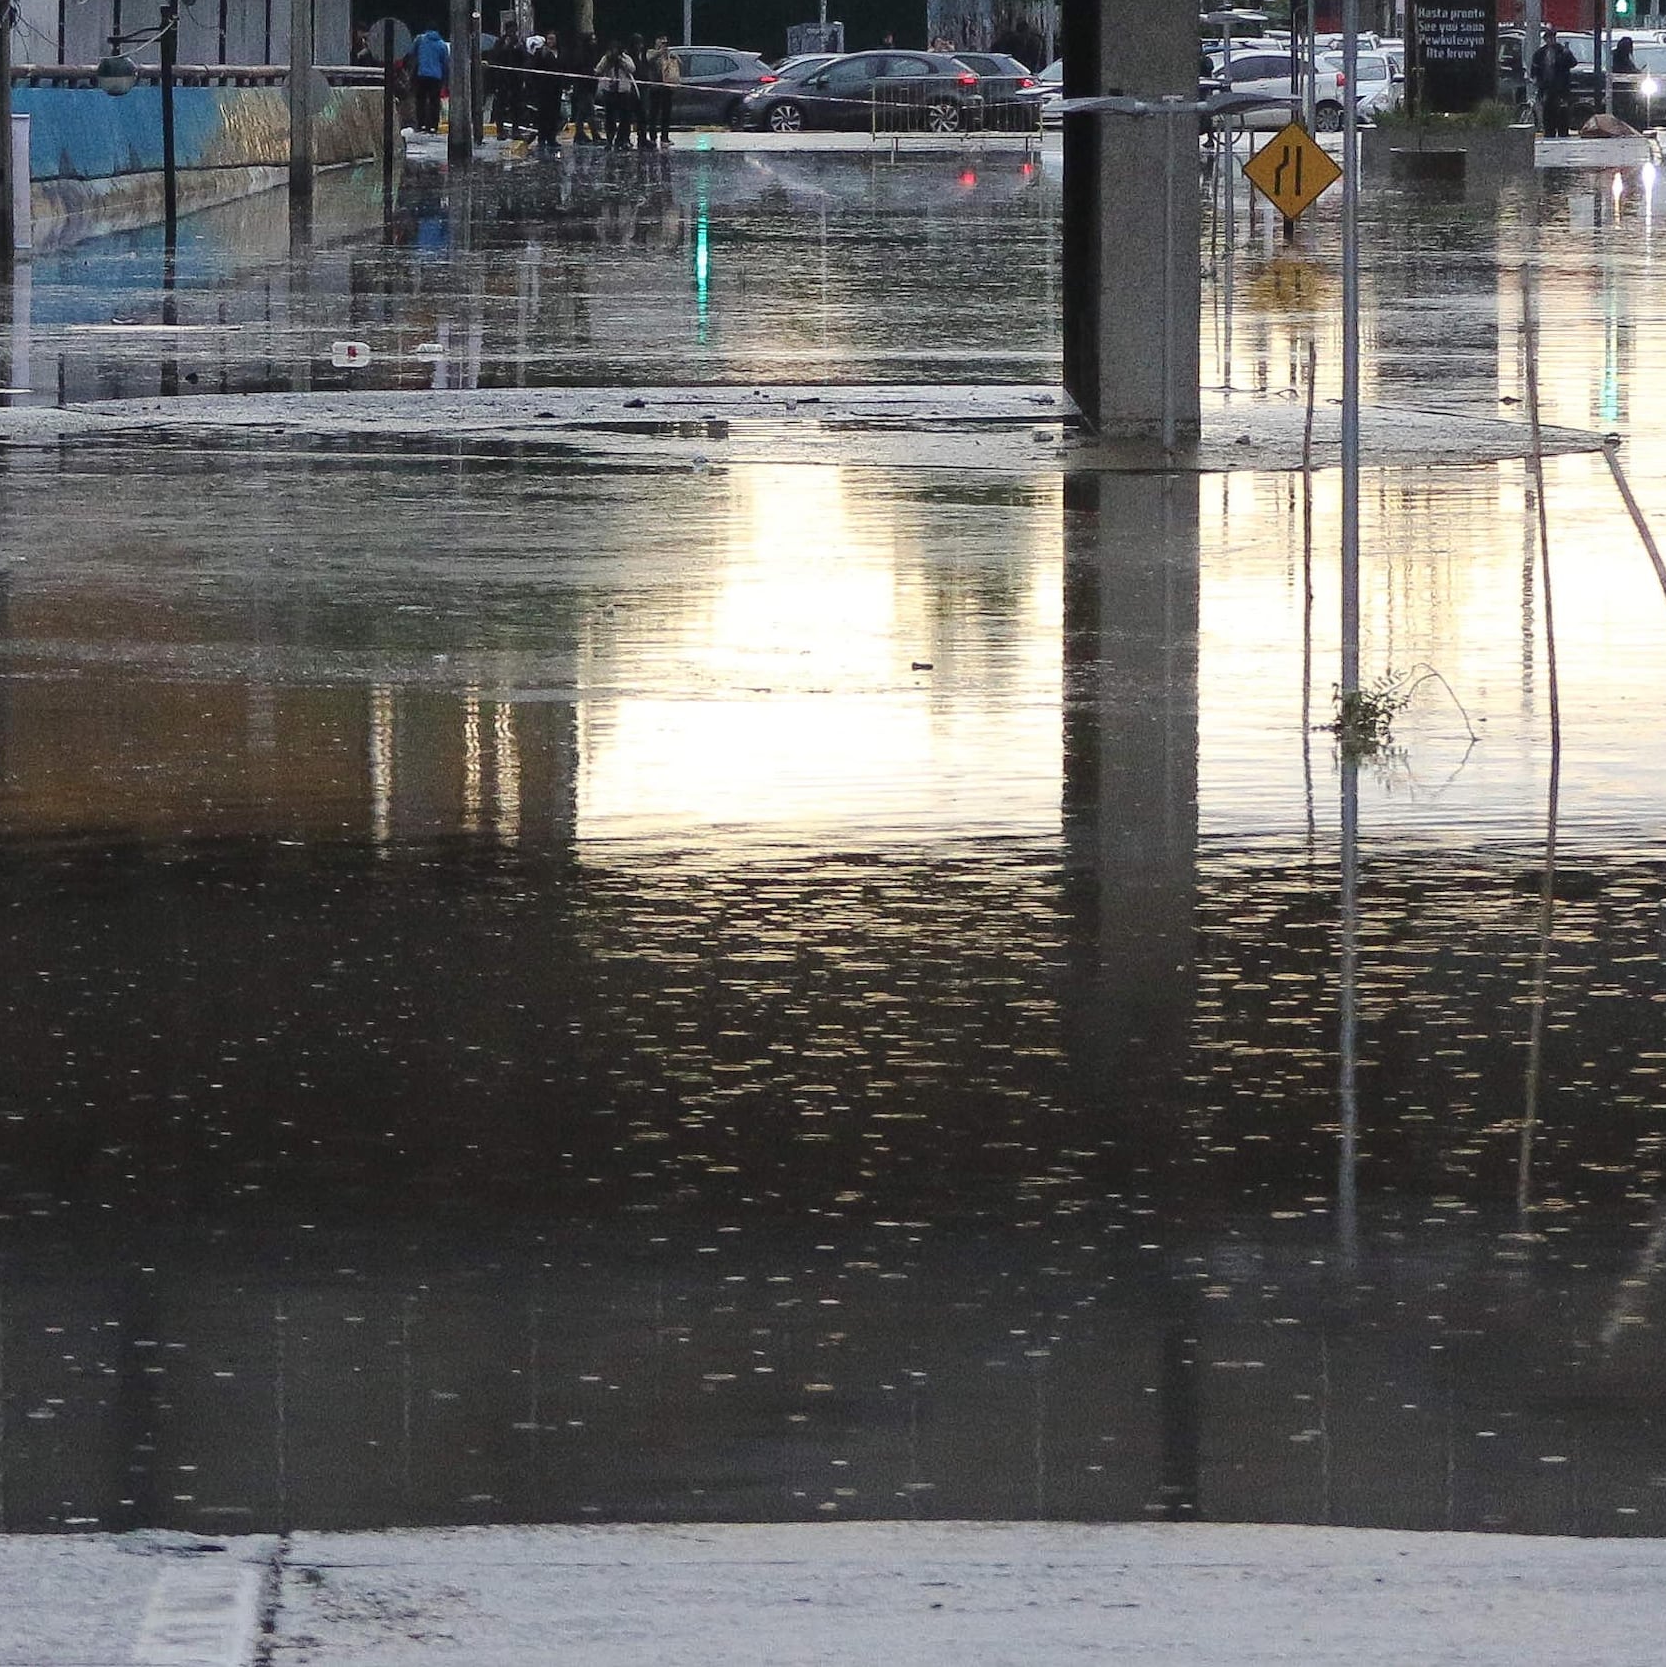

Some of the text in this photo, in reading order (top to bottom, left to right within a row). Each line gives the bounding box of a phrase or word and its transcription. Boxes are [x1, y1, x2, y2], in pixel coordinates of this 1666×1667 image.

[1450, 8, 1485, 21] pronto
[1418, 20, 1485, 35] See you soon
